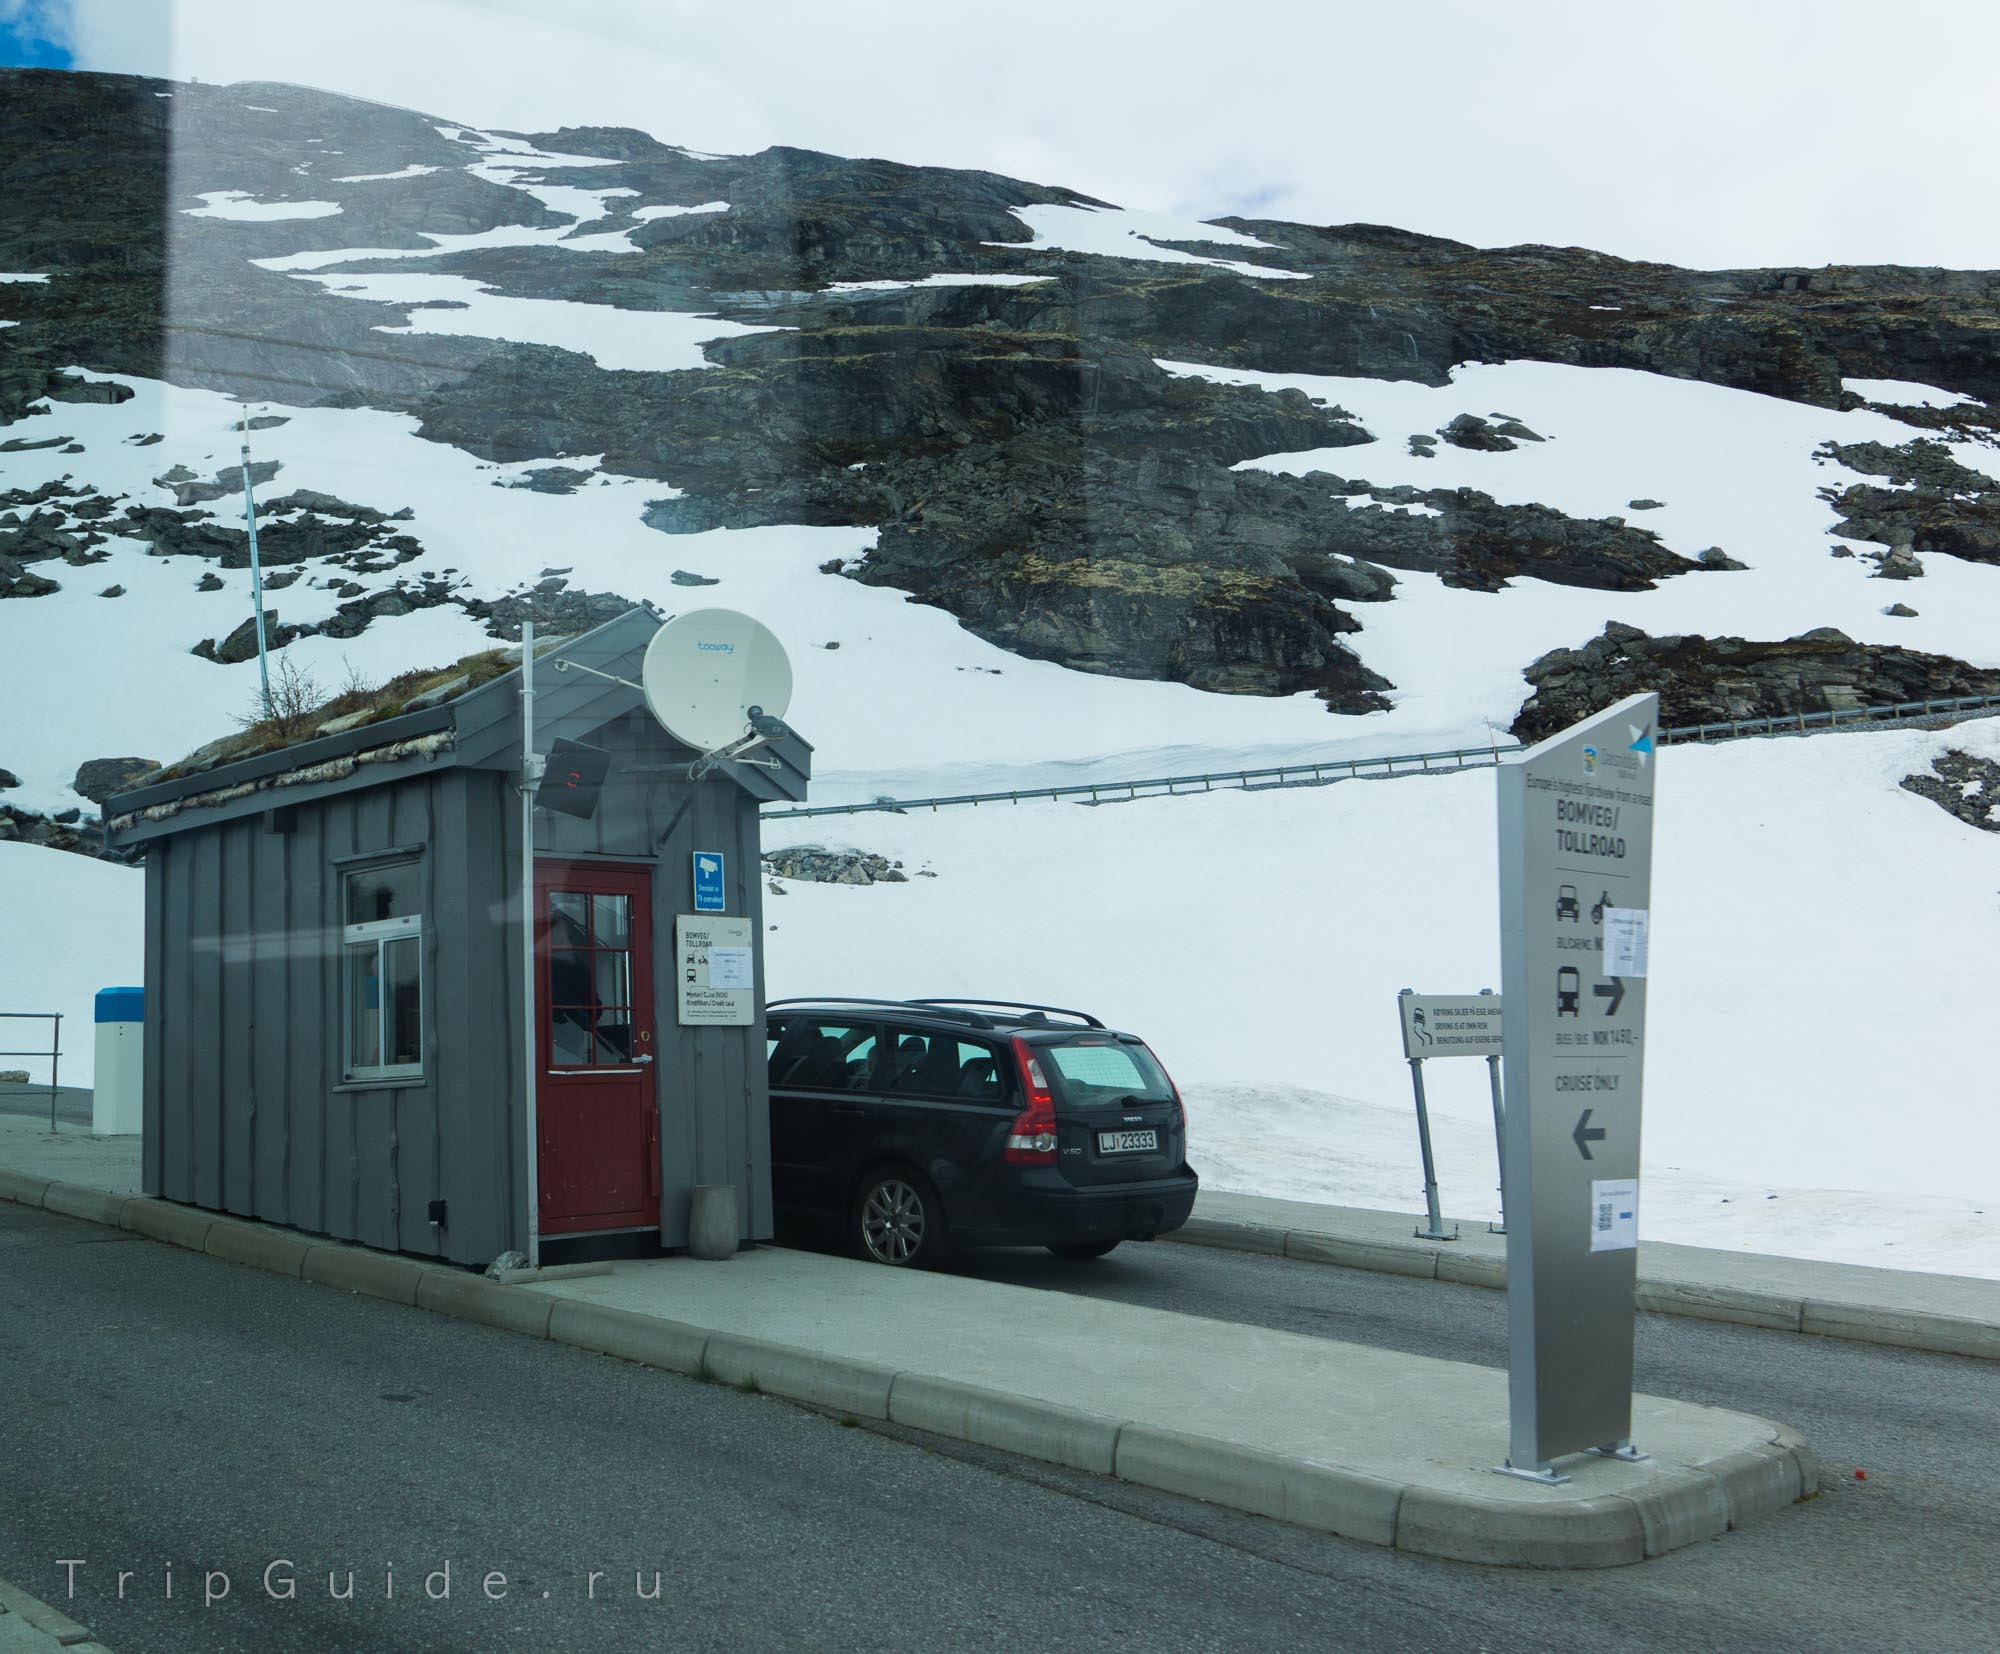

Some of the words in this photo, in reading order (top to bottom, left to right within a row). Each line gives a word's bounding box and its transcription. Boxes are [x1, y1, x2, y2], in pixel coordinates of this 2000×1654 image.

[697, 642, 735, 655] tooway
[1556, 799, 1620, 831] BOMVEG/
[1556, 829, 1625, 859] TOLLROAD
[685, 931, 710, 940] BOMVEG/
[1554, 1074, 1593, 1092] CRUISE
[1593, 1074, 1621, 1091] ONLY
[1101, 1134, 1116, 1151] LJ
[1120, 1131, 1154, 1149] 23333
